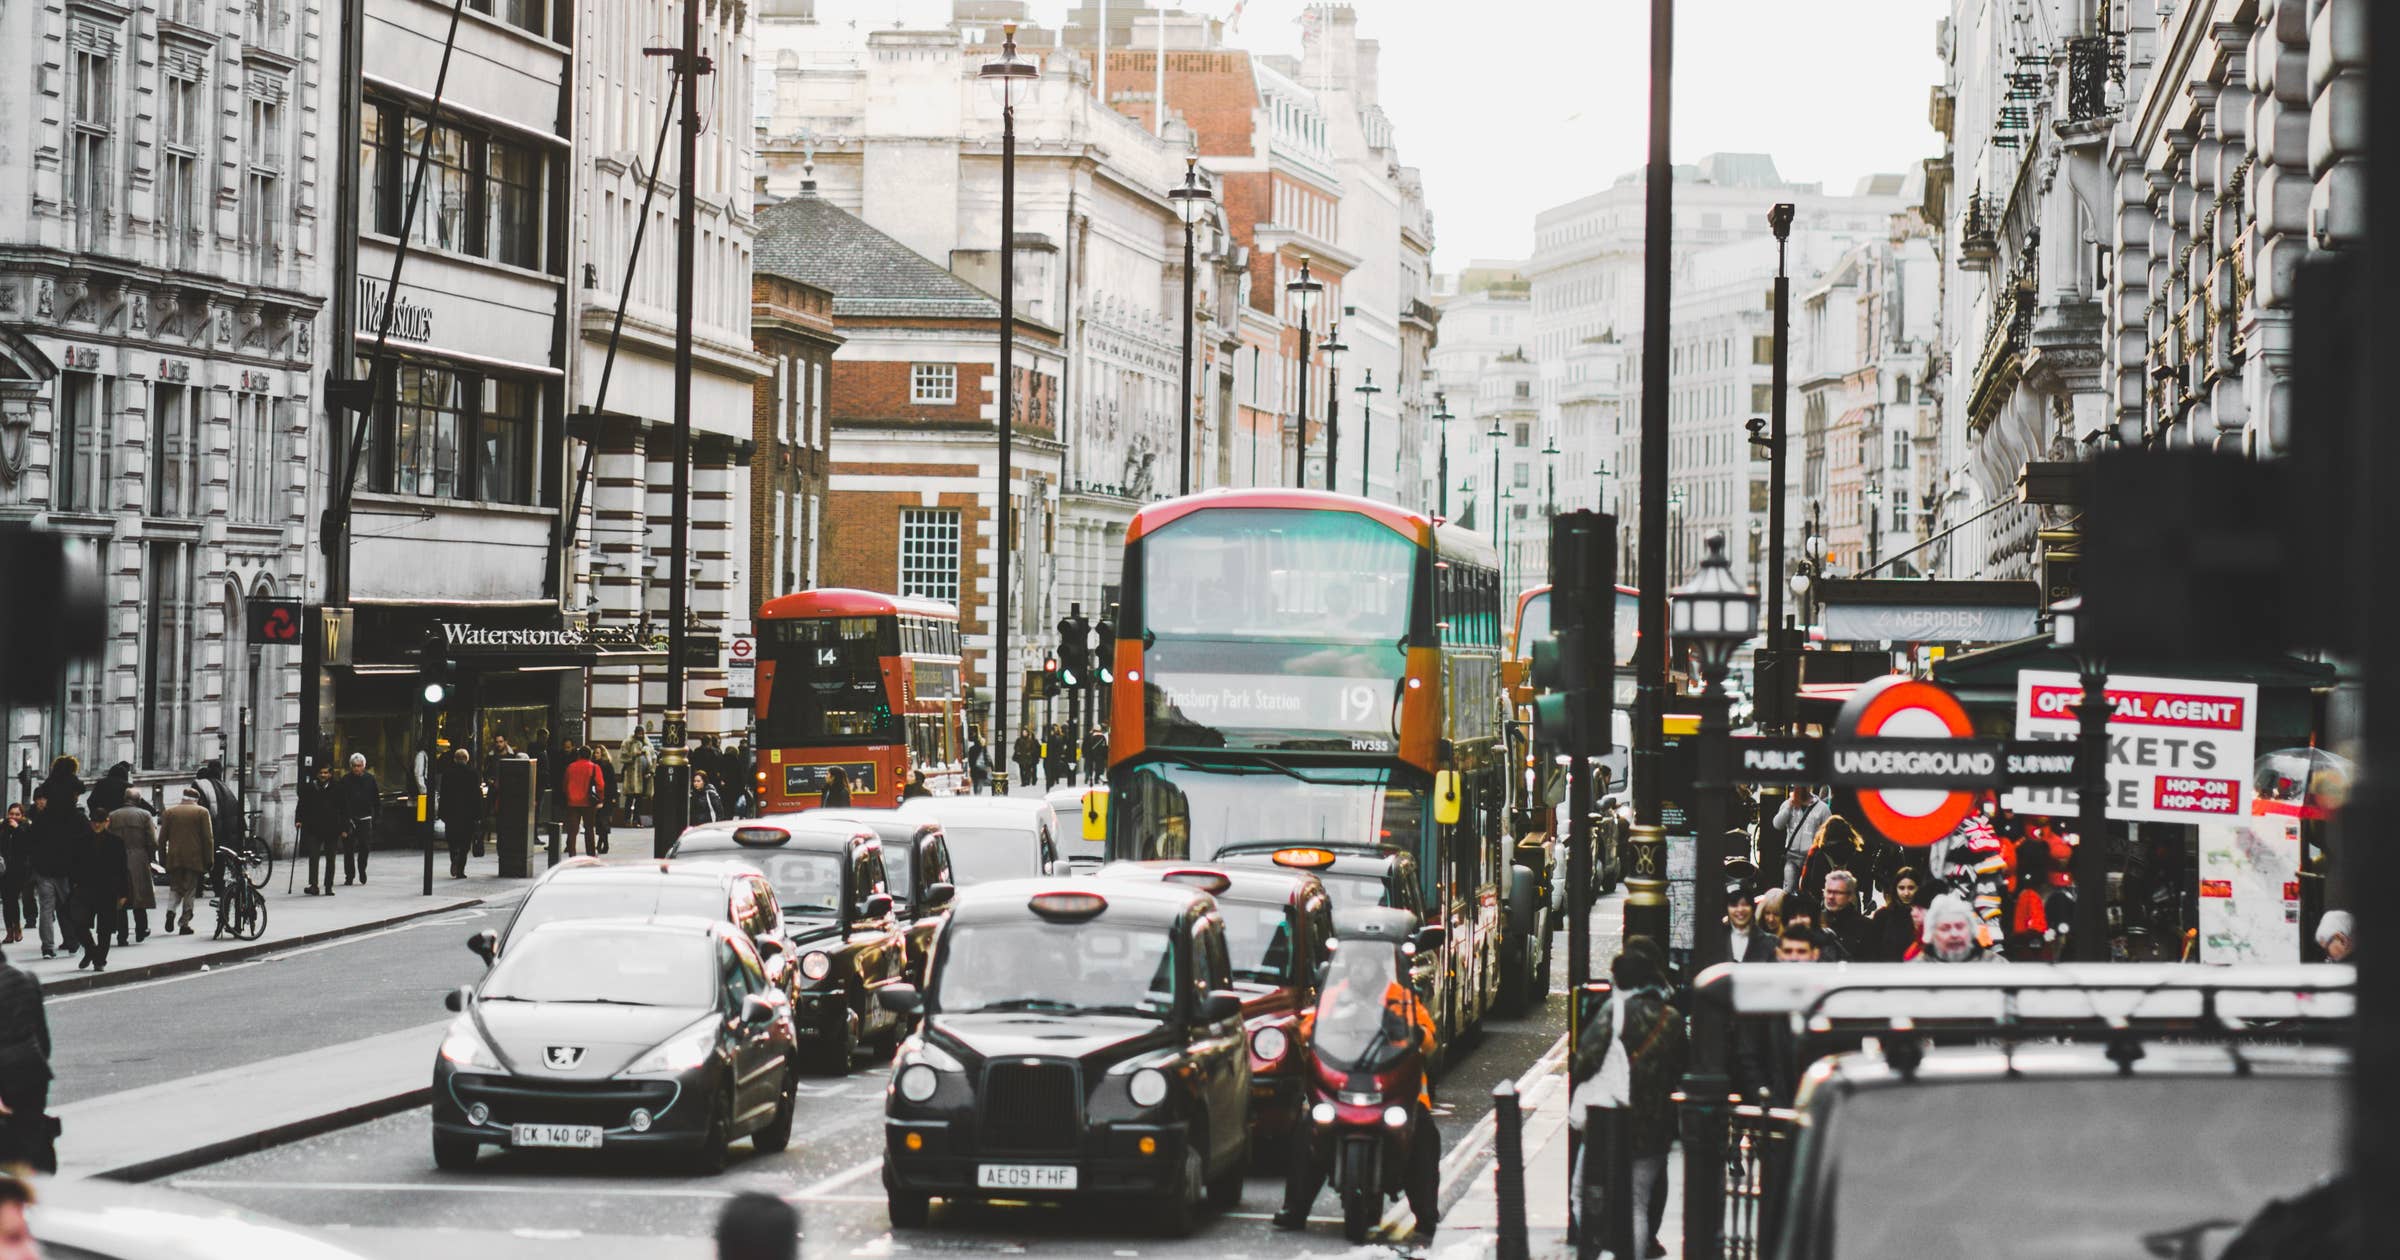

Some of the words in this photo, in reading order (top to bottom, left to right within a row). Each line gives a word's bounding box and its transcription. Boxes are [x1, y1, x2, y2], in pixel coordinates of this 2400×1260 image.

[1895, 611, 1983, 627] MERIDIEN
[325, 619, 340, 660] W
[442, 624, 583, 646] Waterstones
[817, 649, 837, 665] 14
[1167, 687, 1218, 713] Finsbury
[1222, 688, 1250, 710] Park
[1255, 689, 1301, 711] Station
[1340, 687, 1375, 721] 19
[2037, 691, 2148, 718] OFFAL
[2152, 700, 2235, 723] AGENT
[2030, 731, 2217, 769] KETS
[1744, 751, 1806, 770] PUBLIC
[1833, 751, 1995, 775] UNDERGROUND
[2007, 755, 2075, 773] SUBWAY
[2166, 779, 2228, 795] HOP-ON
[2162, 794, 2231, 811] HOP-OFF
[523, 1127, 537, 1141] CK
[547, 1128, 569, 1143] 140
[576, 1129, 591, 1143] GP
[987, 1168, 1030, 1185] AE09
[1036, 1169, 1069, 1185] FHF
